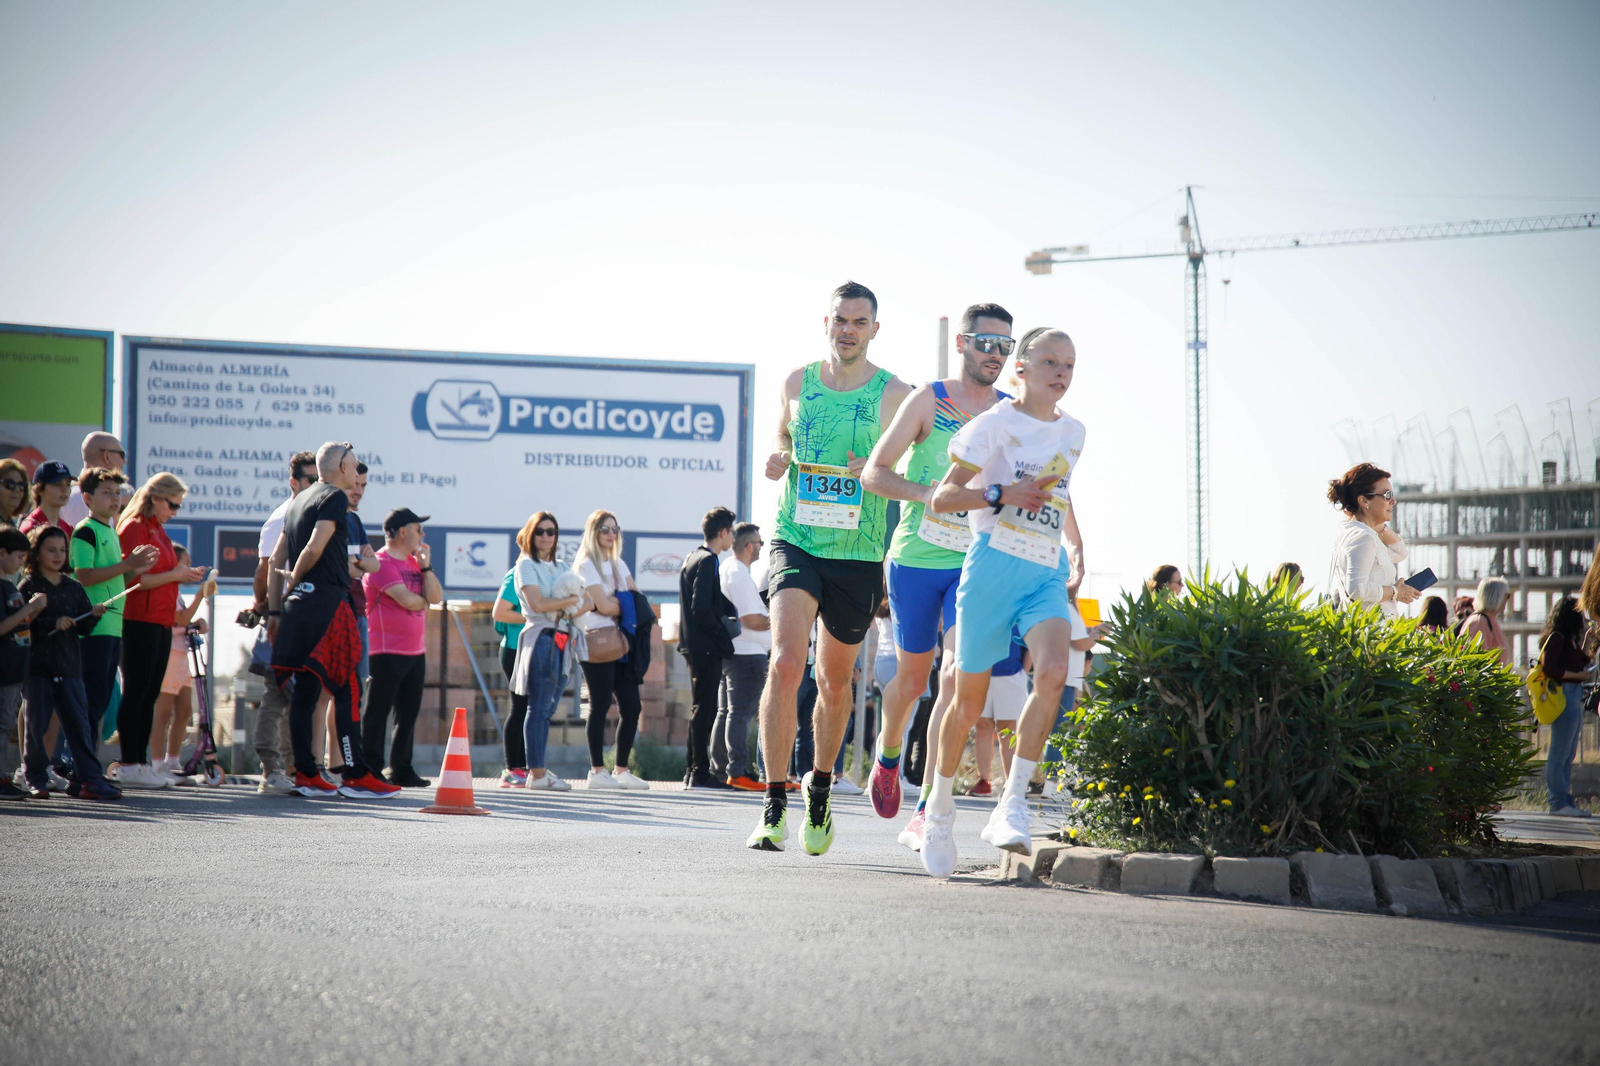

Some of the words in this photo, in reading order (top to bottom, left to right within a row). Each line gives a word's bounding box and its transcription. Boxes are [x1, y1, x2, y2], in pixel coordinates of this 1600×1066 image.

[149, 360, 213, 374] Almacén
[219, 362, 290, 378] ALMERÍA
[147, 377, 210, 391] (Camino
[215, 380, 232, 392] de
[238, 381, 255, 393] La
[260, 382, 307, 396] Goleta
[312, 384, 336, 399] 34)
[147, 395, 177, 407] 950
[181, 396, 210, 409] 222
[215, 398, 244, 410] 055
[272, 400, 300, 413] 629
[305, 401, 332, 414] 286
[338, 402, 365, 415] 555
[148, 411, 293, 429] info@prodicoyde.es
[508, 398, 715, 439] Prodicoyde
[148, 446, 213, 459] Almacén
[218, 449, 284, 462] ALHAMA
[356, 451, 383, 466] RÍA
[524, 452, 649, 469] DISTRIBUIDOR
[658, 457, 725, 472] OFICIAL
[194, 465, 239, 478] Gador
[368, 472, 395, 485] raje
[401, 472, 415, 484] El
[420, 473, 457, 488] Pago)
[804, 474, 858, 498] 1349
[189, 484, 208, 496] 01
[214, 485, 243, 497] 016
[817, 494, 838, 502] JAVIER
[342, 735, 354, 767] Joma
